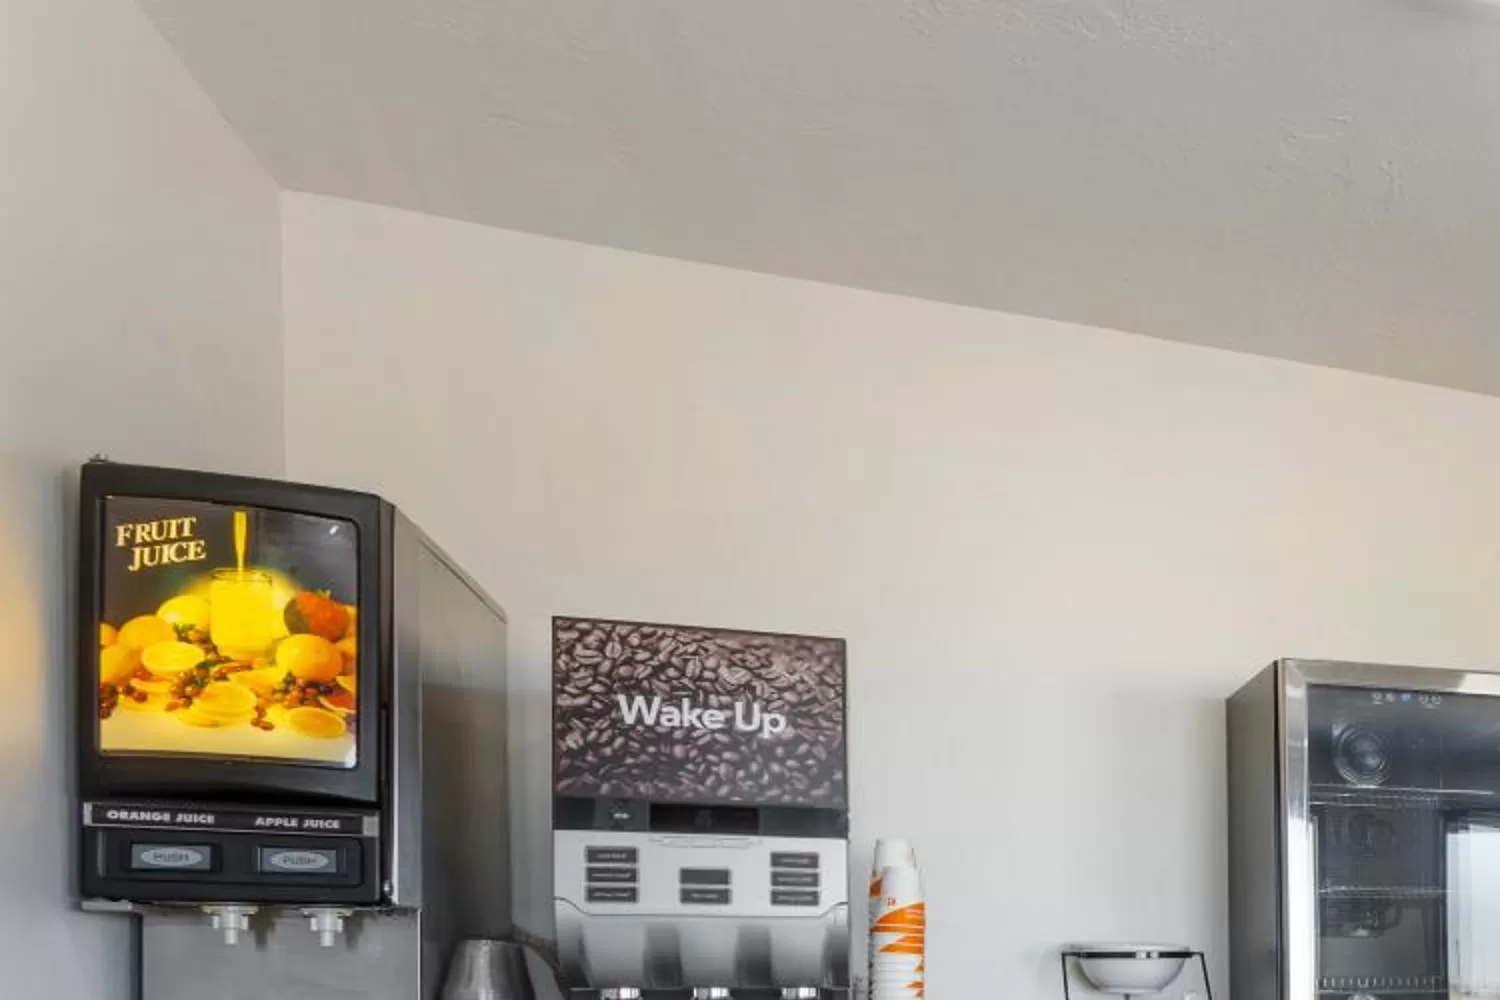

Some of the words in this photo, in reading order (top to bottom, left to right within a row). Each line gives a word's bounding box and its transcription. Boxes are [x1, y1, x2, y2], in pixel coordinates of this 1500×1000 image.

[115, 516, 197, 547] FRUIT
[128, 540, 207, 572] JUICE
[617, 693, 726, 729] Wake
[734, 701, 787, 739] Up
[106, 809, 171, 823] ORANGE
[175, 813, 215, 825] JUICE
[254, 817, 298, 828] APPLE
[303, 819, 340, 830] JUICE
[152, 852, 189, 863] PUSH
[283, 855, 317, 865] PUSH
